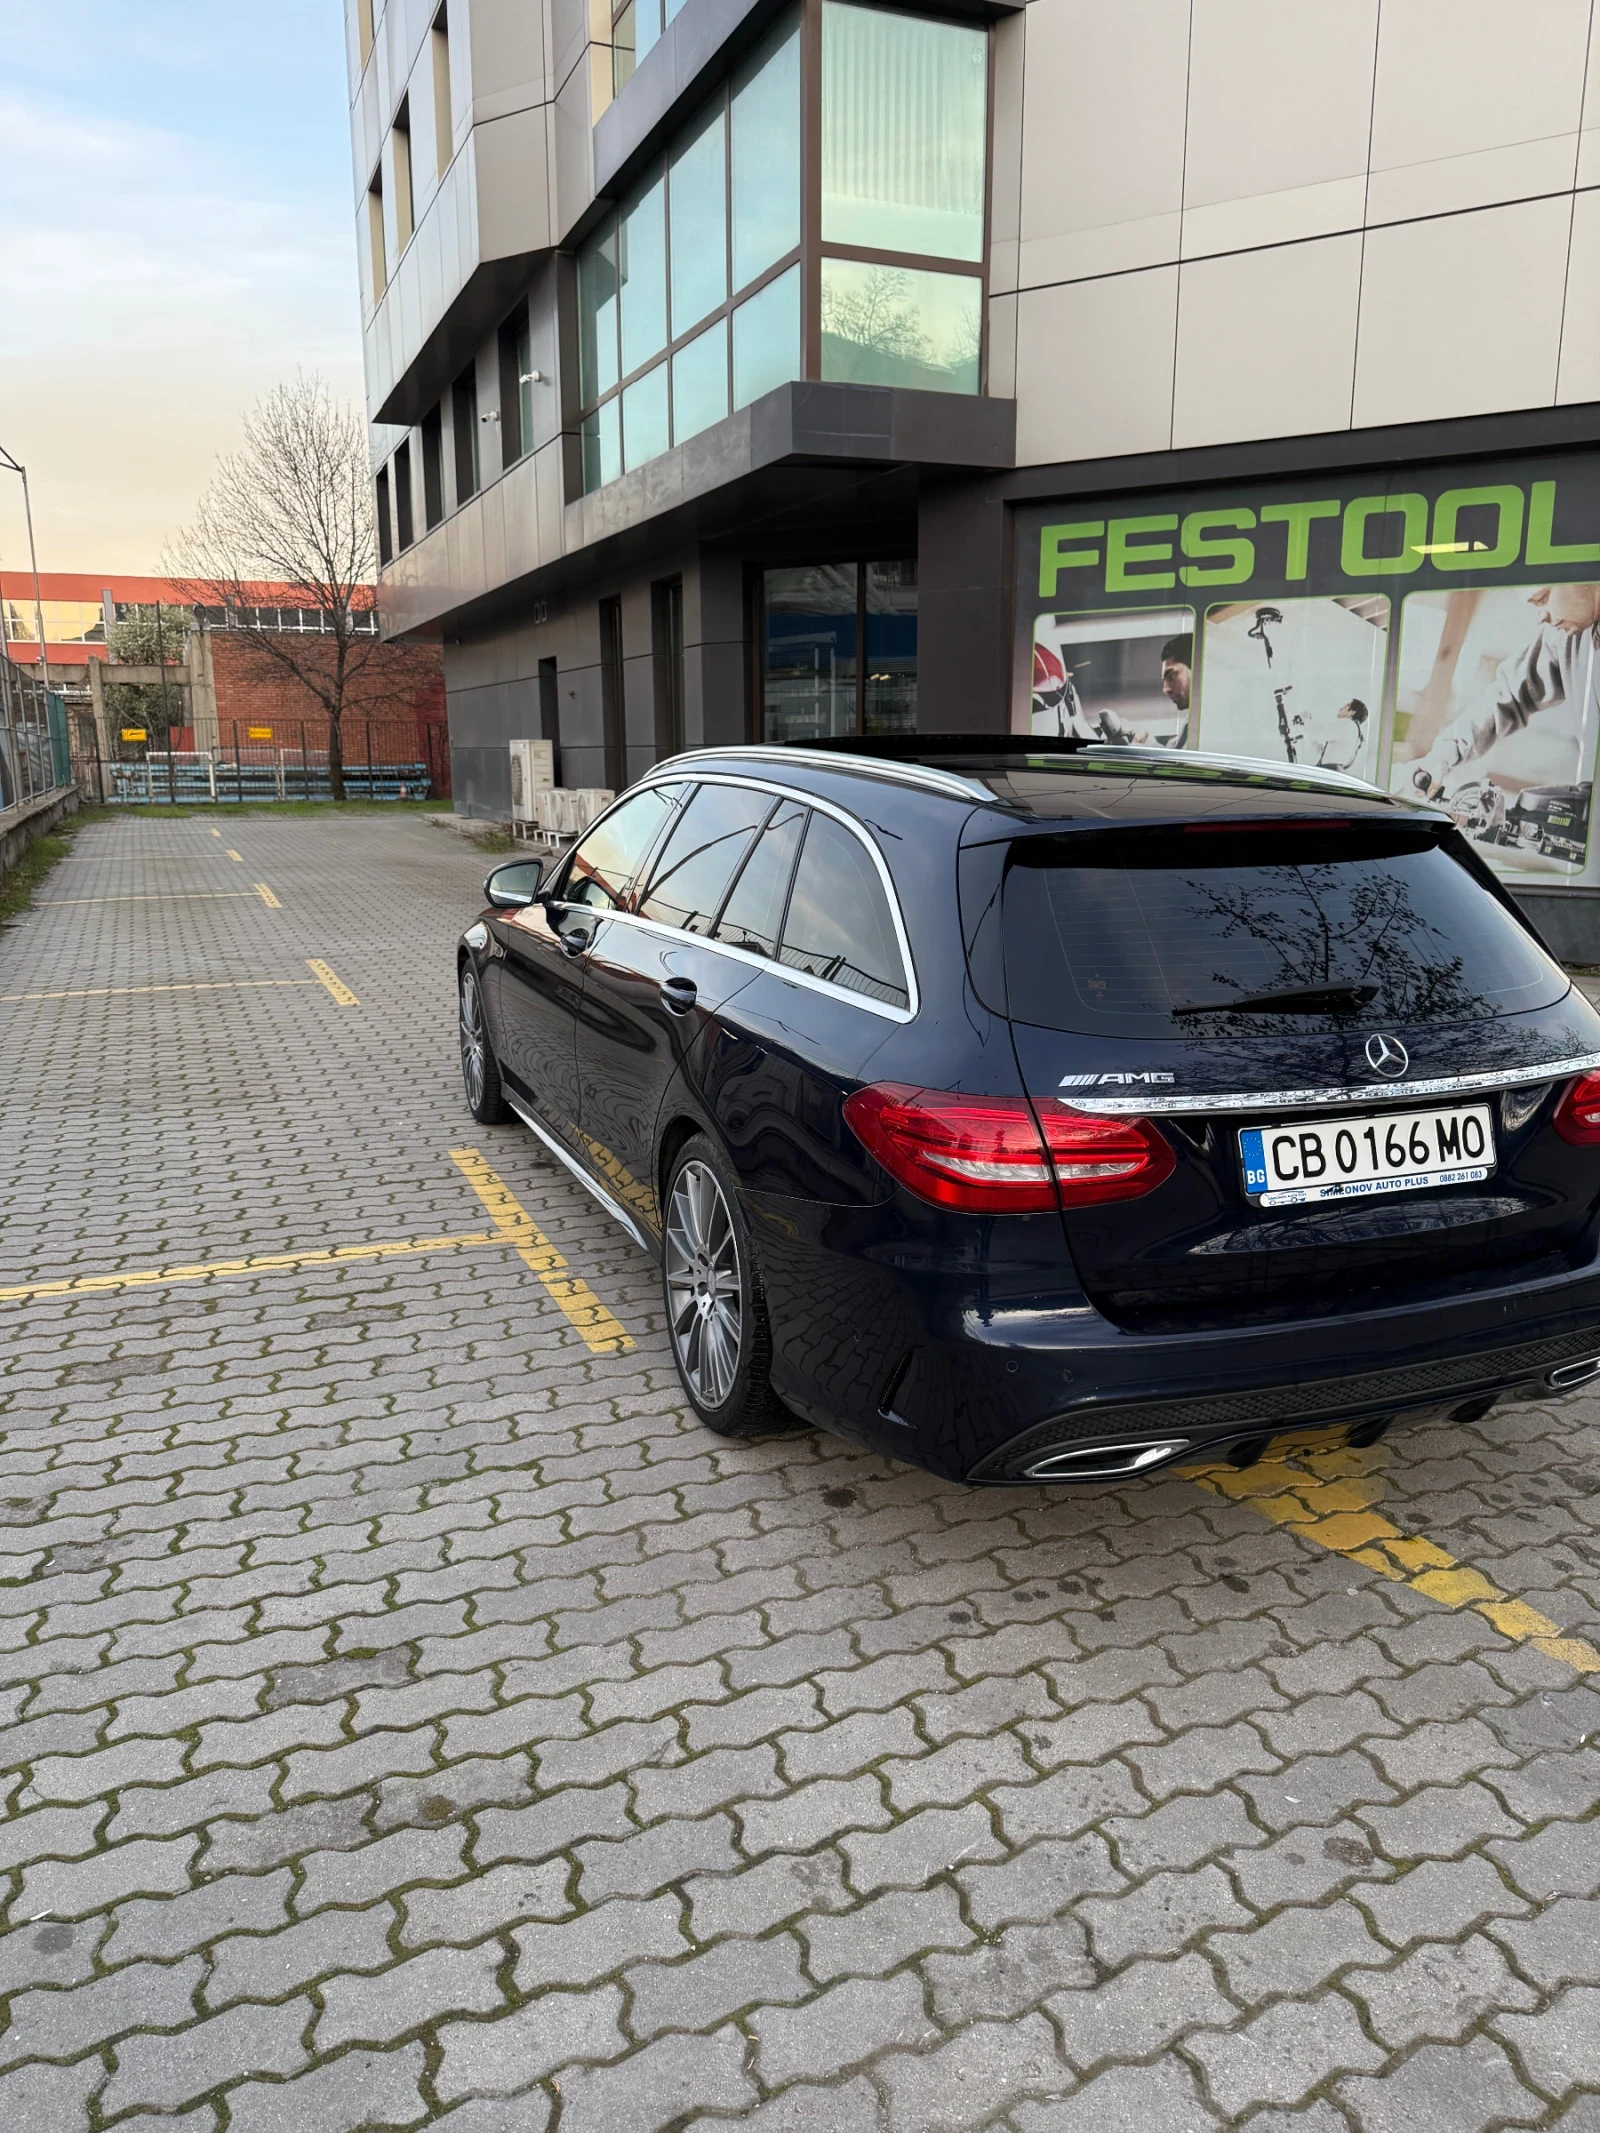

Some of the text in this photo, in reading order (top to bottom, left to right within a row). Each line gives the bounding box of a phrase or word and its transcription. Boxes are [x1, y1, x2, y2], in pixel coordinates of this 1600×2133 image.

[1039, 480, 1600, 598] FESTOOL
[1097, 1072, 1175, 1085] AMG
[1272, 1115, 1486, 1181] CB 0166 MO
[1246, 1169, 1266, 1185] BG
[1375, 1179, 1402, 1190] AUTO
[1404, 1176, 1429, 1187] PLUS
[1439, 1173, 1456, 1183] 0882
[1457, 1171, 1469, 1181] 261
[1470, 1170, 1483, 1180] 083
